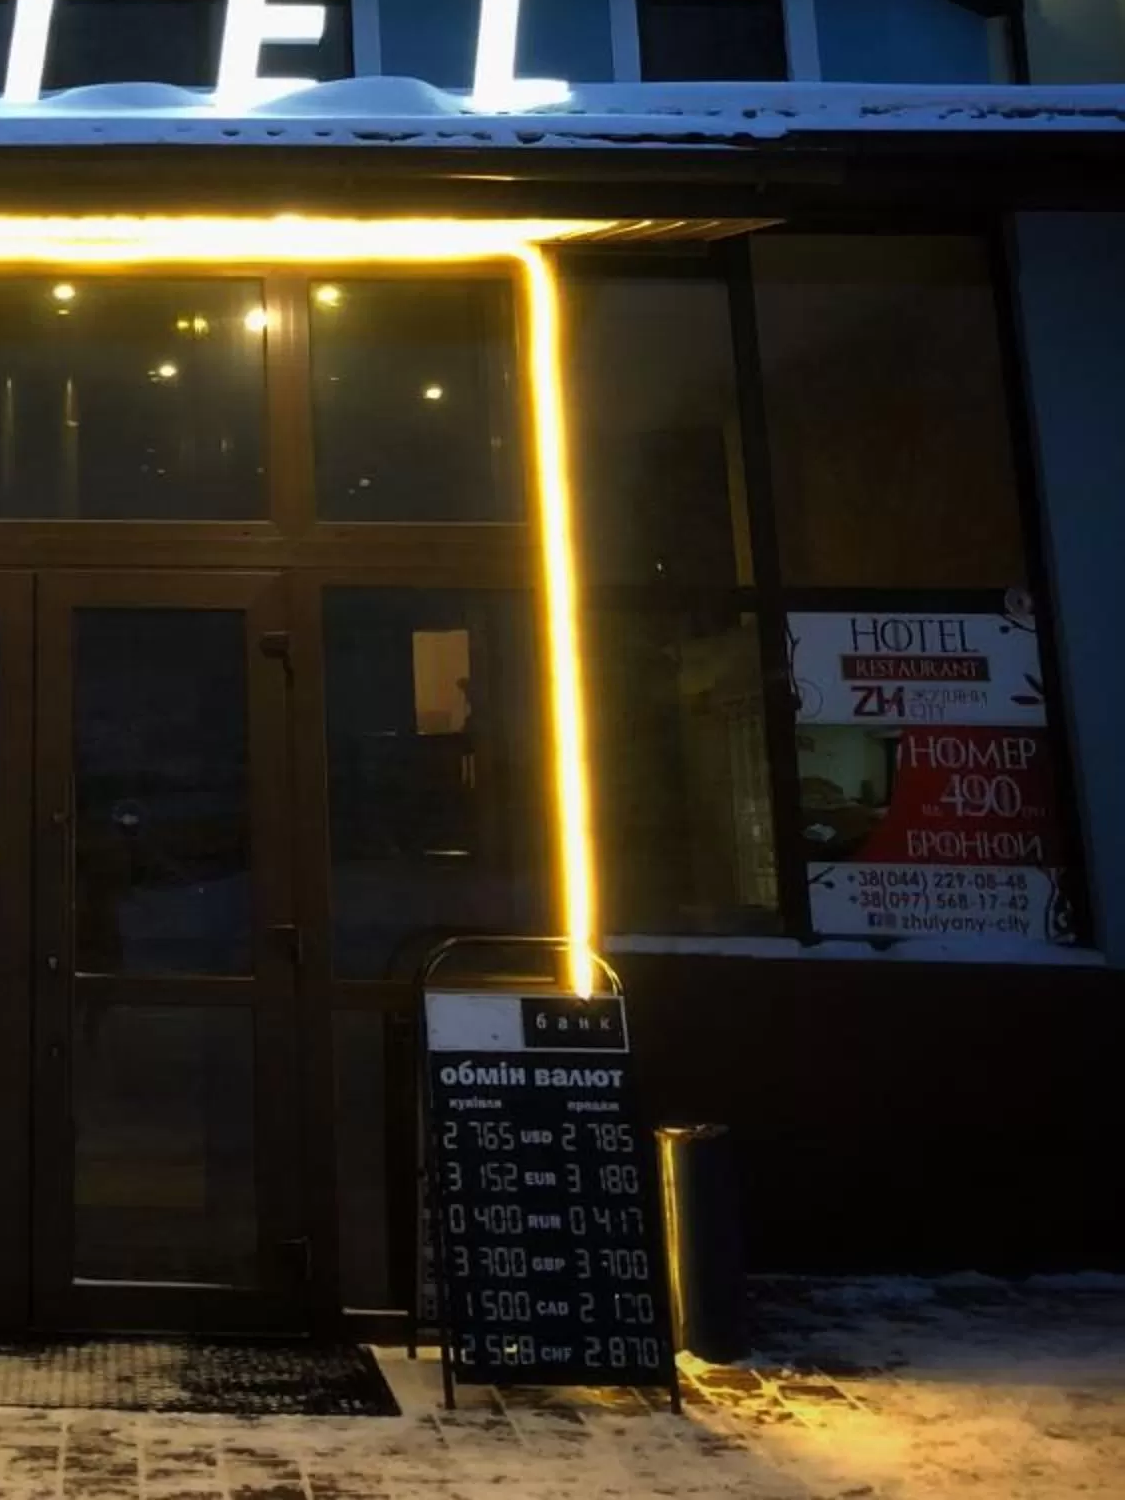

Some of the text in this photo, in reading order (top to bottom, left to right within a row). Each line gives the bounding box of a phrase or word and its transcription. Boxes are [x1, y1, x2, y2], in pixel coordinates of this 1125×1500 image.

[850, 617, 979, 653] HOTEL
[855, 658, 980, 679] RESTAURANT
[906, 736, 1036, 770] НОМЕР
[938, 773, 1023, 818] 490
[906, 829, 1043, 860] БРОНЮЙ
[902, 913, 1031, 935] zhulyany-city
[536, 1012, 611, 1030] банк
[439, 1060, 624, 1088] обмін валют
[520, 1129, 553, 1145] USD
[523, 1171, 556, 1185] EUR
[531, 1256, 566, 1272] GBP
[535, 1299, 569, 1316] CAD
[539, 1346, 573, 1362] CHF
